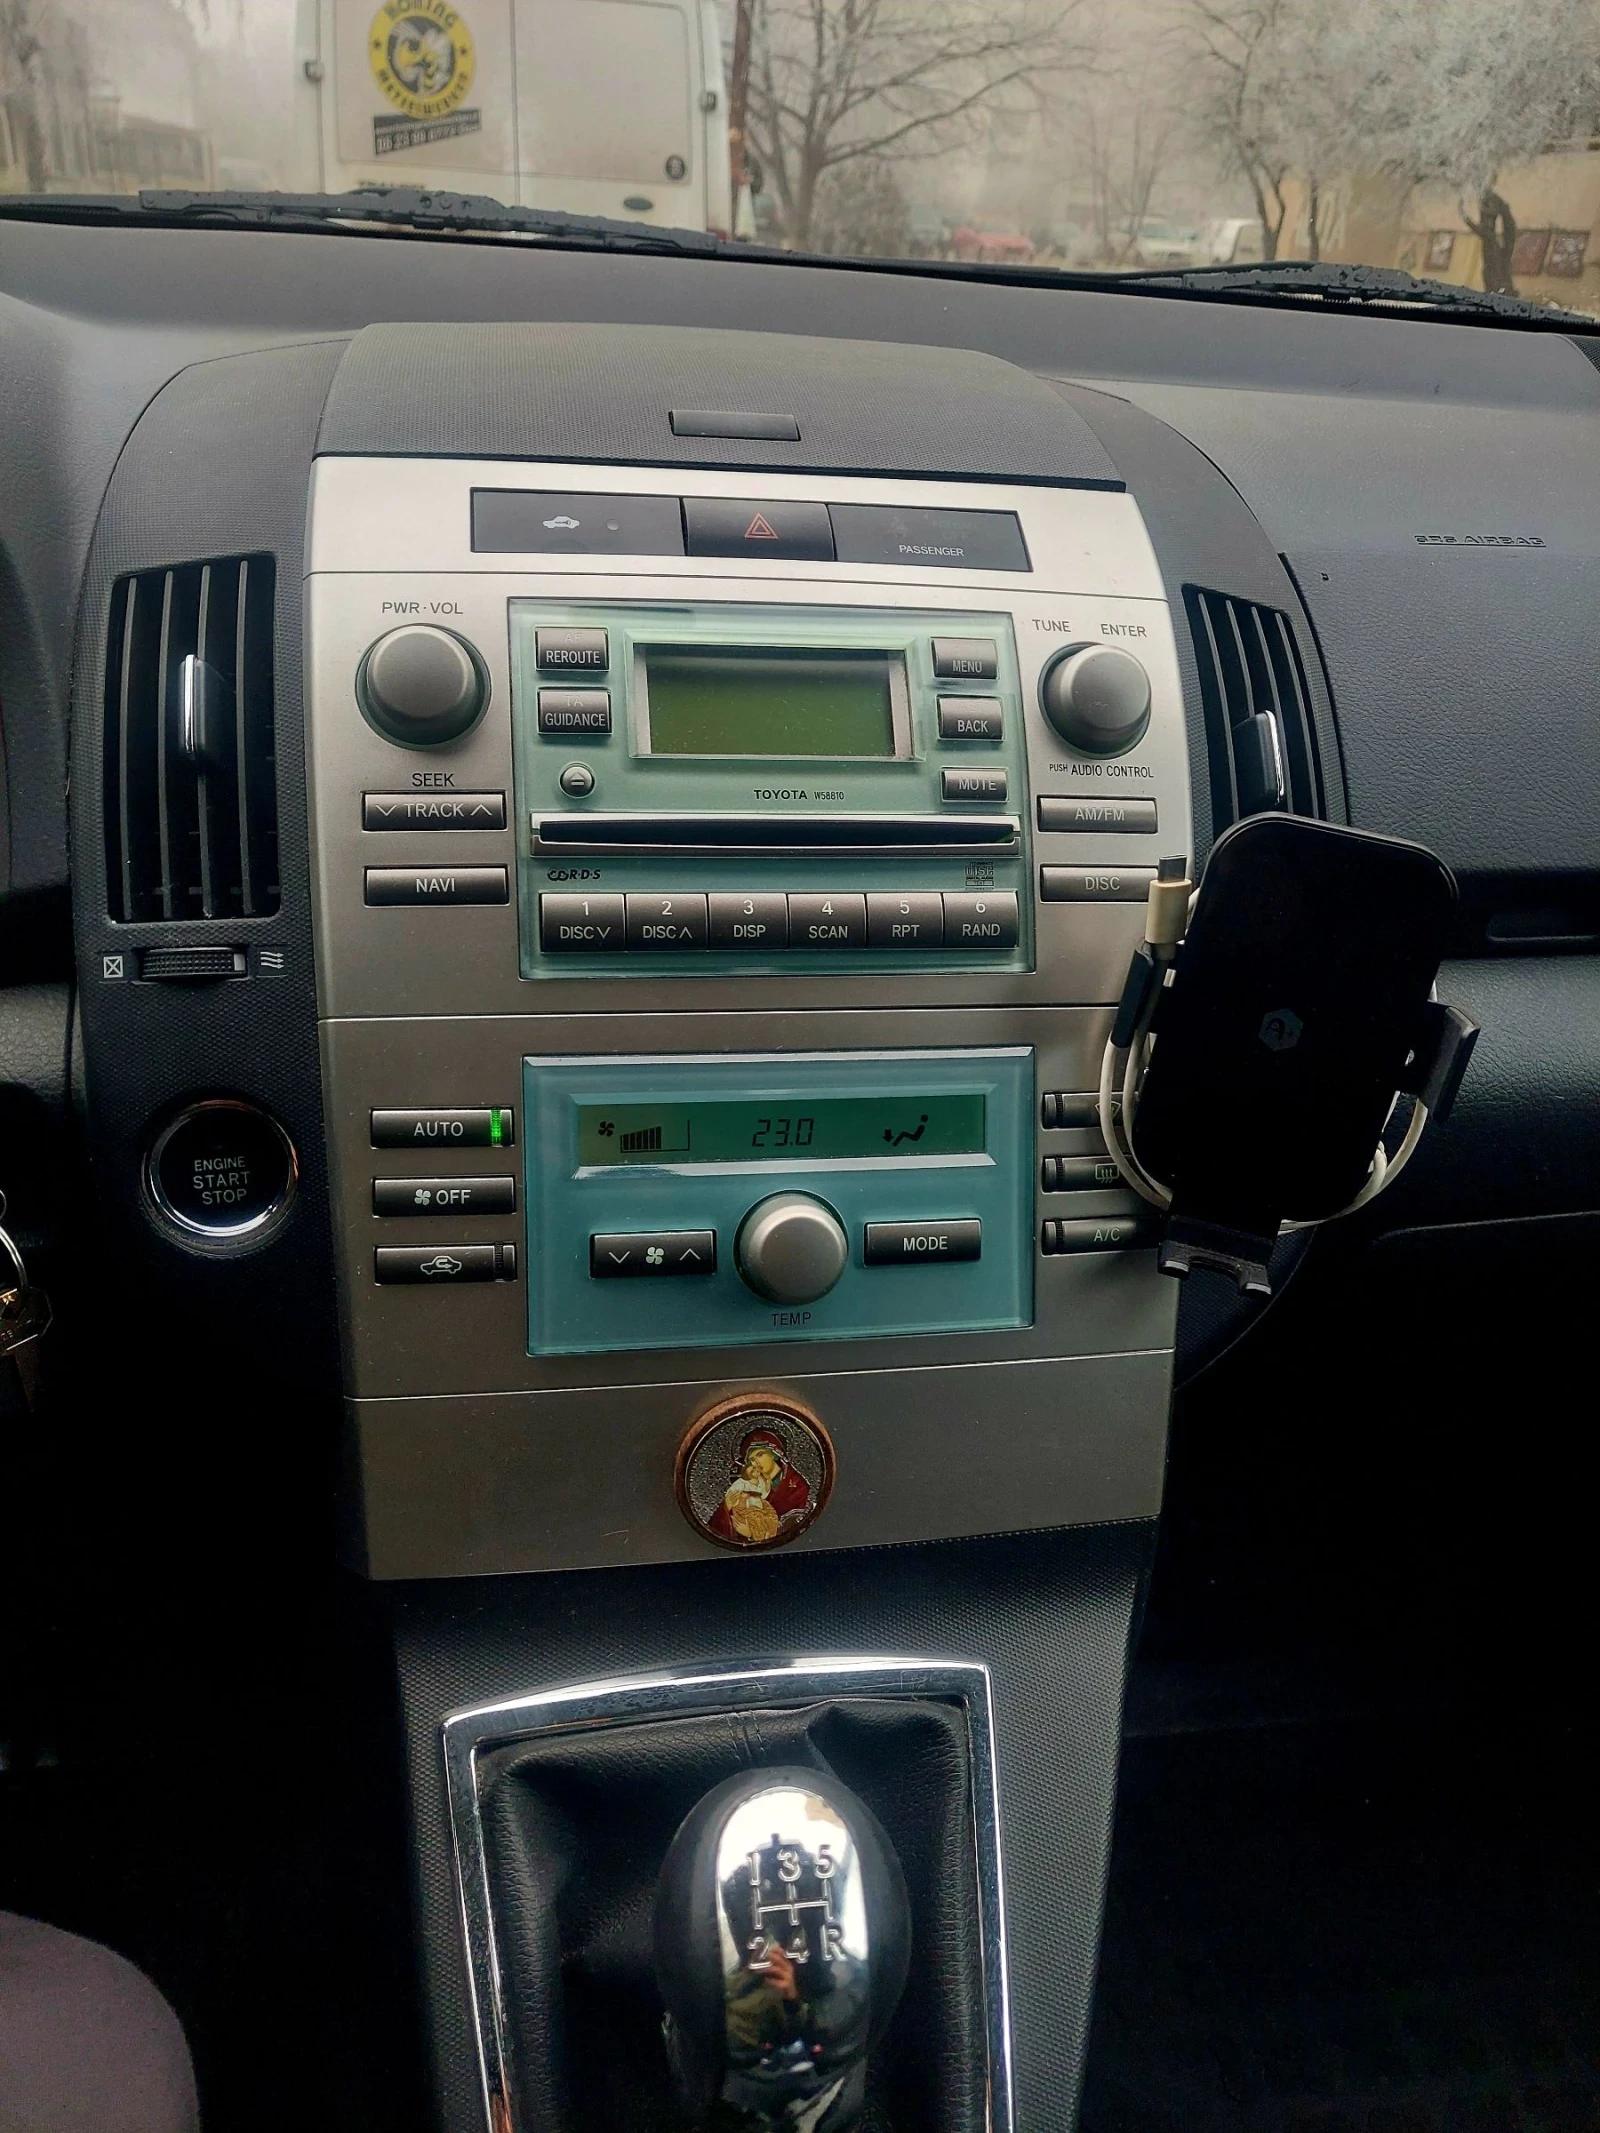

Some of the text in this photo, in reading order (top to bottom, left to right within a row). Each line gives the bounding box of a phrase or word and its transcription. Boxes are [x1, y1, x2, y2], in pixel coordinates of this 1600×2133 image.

[1414, 535, 1546, 545] SRS AIRBAG
[899, 543, 965, 558] PASSENGER
[1032, 619, 1072, 633] TUNE
[1100, 623, 1148, 637] ENTER
[564, 633, 582, 645] AF
[546, 650, 601, 664] REROUTE
[952, 659, 983, 674] MENU
[564, 695, 584, 708] TA
[544, 713, 606, 727] GUIDANCE
[957, 719, 989, 733] BACK
[1049, 763, 1155, 778] PUSH AUDIO CONTROL
[411, 773, 456, 787] SEEK
[958, 777, 997, 791] MUTE
[753, 789, 846, 801] TOYOTA W58810
[404, 803, 465, 818] TRACK
[1074, 806, 1126, 822] AM/FM
[416, 877, 456, 893] NAVI
[1085, 876, 1121, 892] DISC
[581, 900, 590, 916] 1
[661, 899, 673, 917] 2
[742, 899, 754, 916] 3
[821, 899, 834, 916] 4
[899, 899, 911, 916] 5
[974, 899, 987, 915] 6
[559, 925, 595, 940] DISC
[642, 924, 679, 940] DISC
[733, 924, 766, 939] DISP
[808, 924, 849, 940] SCAN
[891, 923, 920, 938] RPT
[961, 922, 1001, 937] RAND
[413, 1121, 464, 1138] AUTO
[751, 1117, 815, 1147] 23.0
[194, 1155, 246, 1172] ENGINE
[193, 1171, 251, 1189] START
[201, 1188, 248, 1205] STOP
[435, 1188, 472, 1205] OFF
[1093, 1226, 1121, 1242] A/C
[902, 1235, 949, 1252] MODE
[770, 1311, 813, 1327] TEMP
[746, 1843, 836, 1886] 1 3 5
[746, 1922, 848, 1970] 2 4 R
